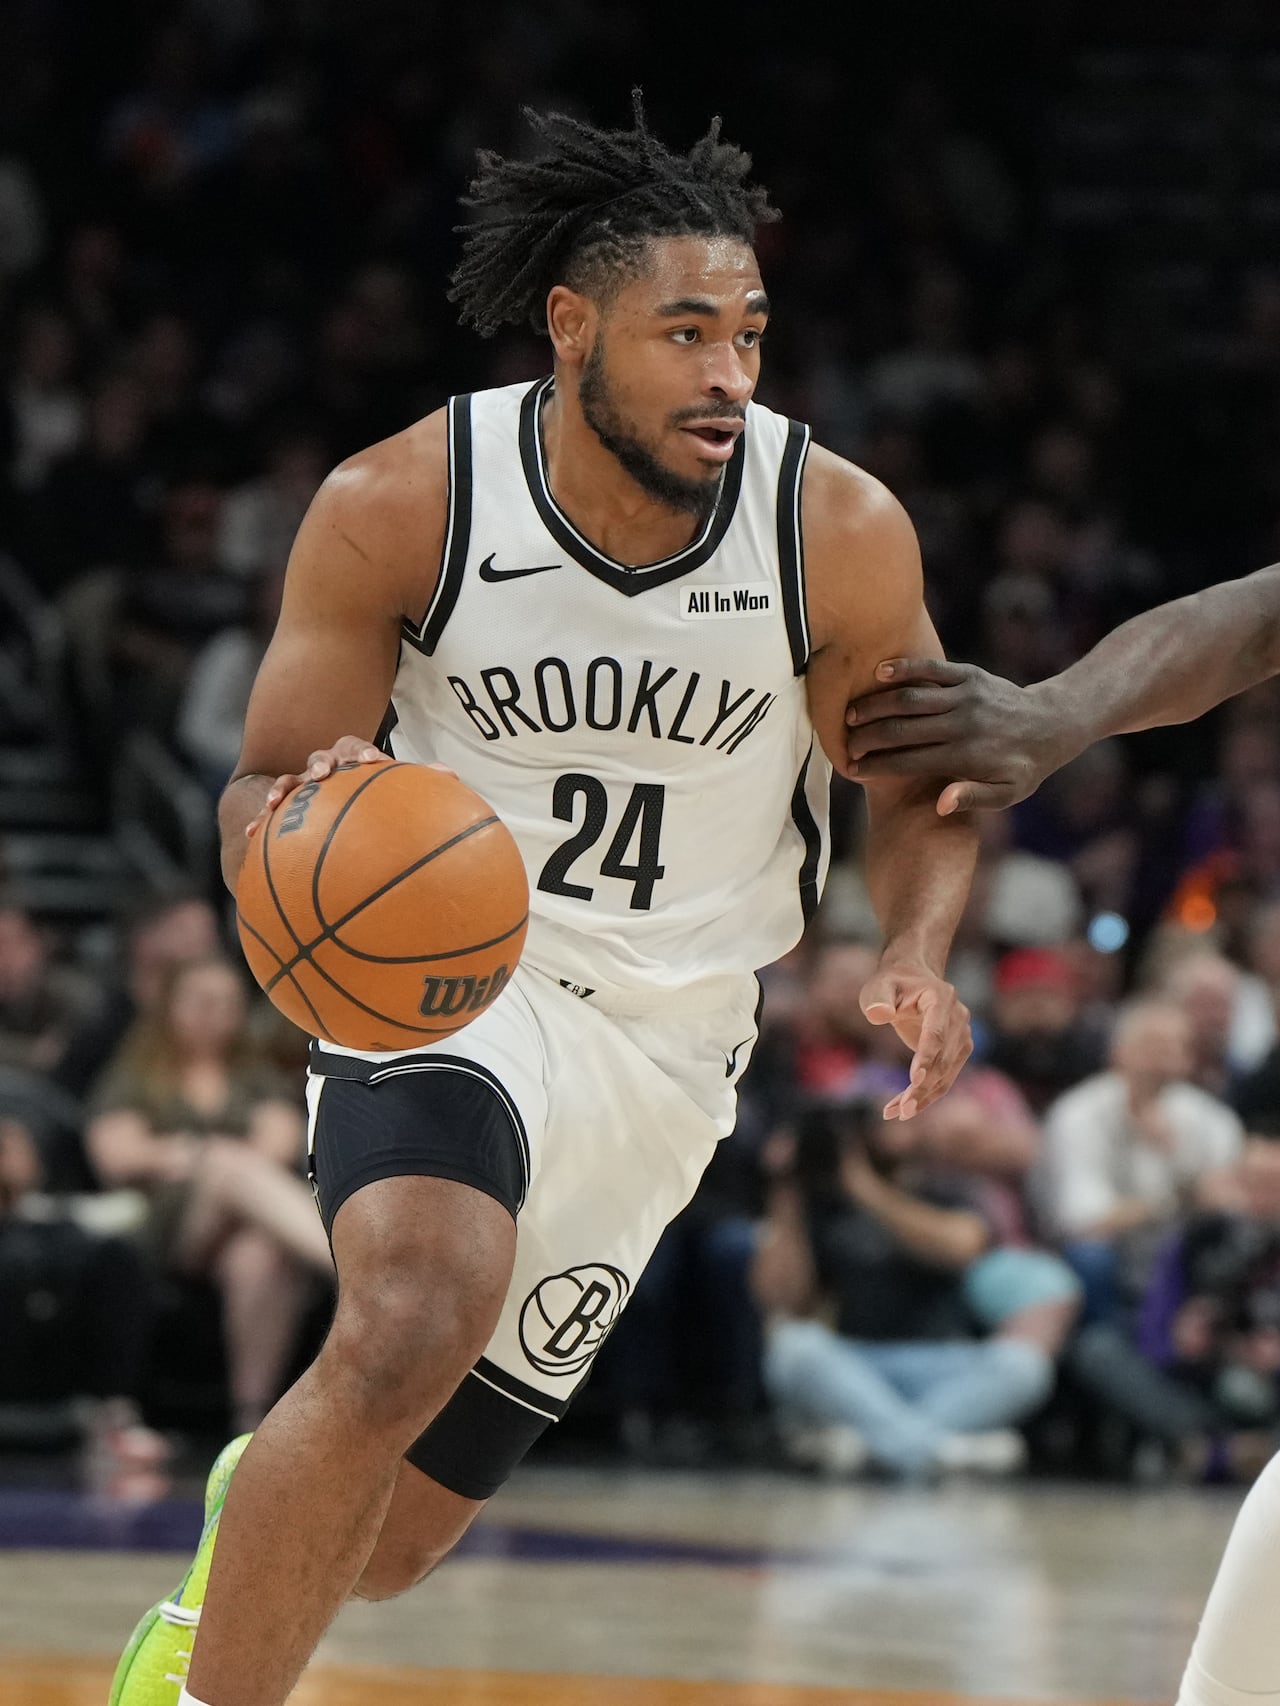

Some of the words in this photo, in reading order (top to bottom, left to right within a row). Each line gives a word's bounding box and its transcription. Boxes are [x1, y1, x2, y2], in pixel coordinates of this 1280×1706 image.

[687, 591, 710, 613] All
[714, 591, 731, 613] In
[733, 589, 770, 612] Won
[446, 656, 778, 756] BROOKLYN
[536, 772, 666, 912] 24
